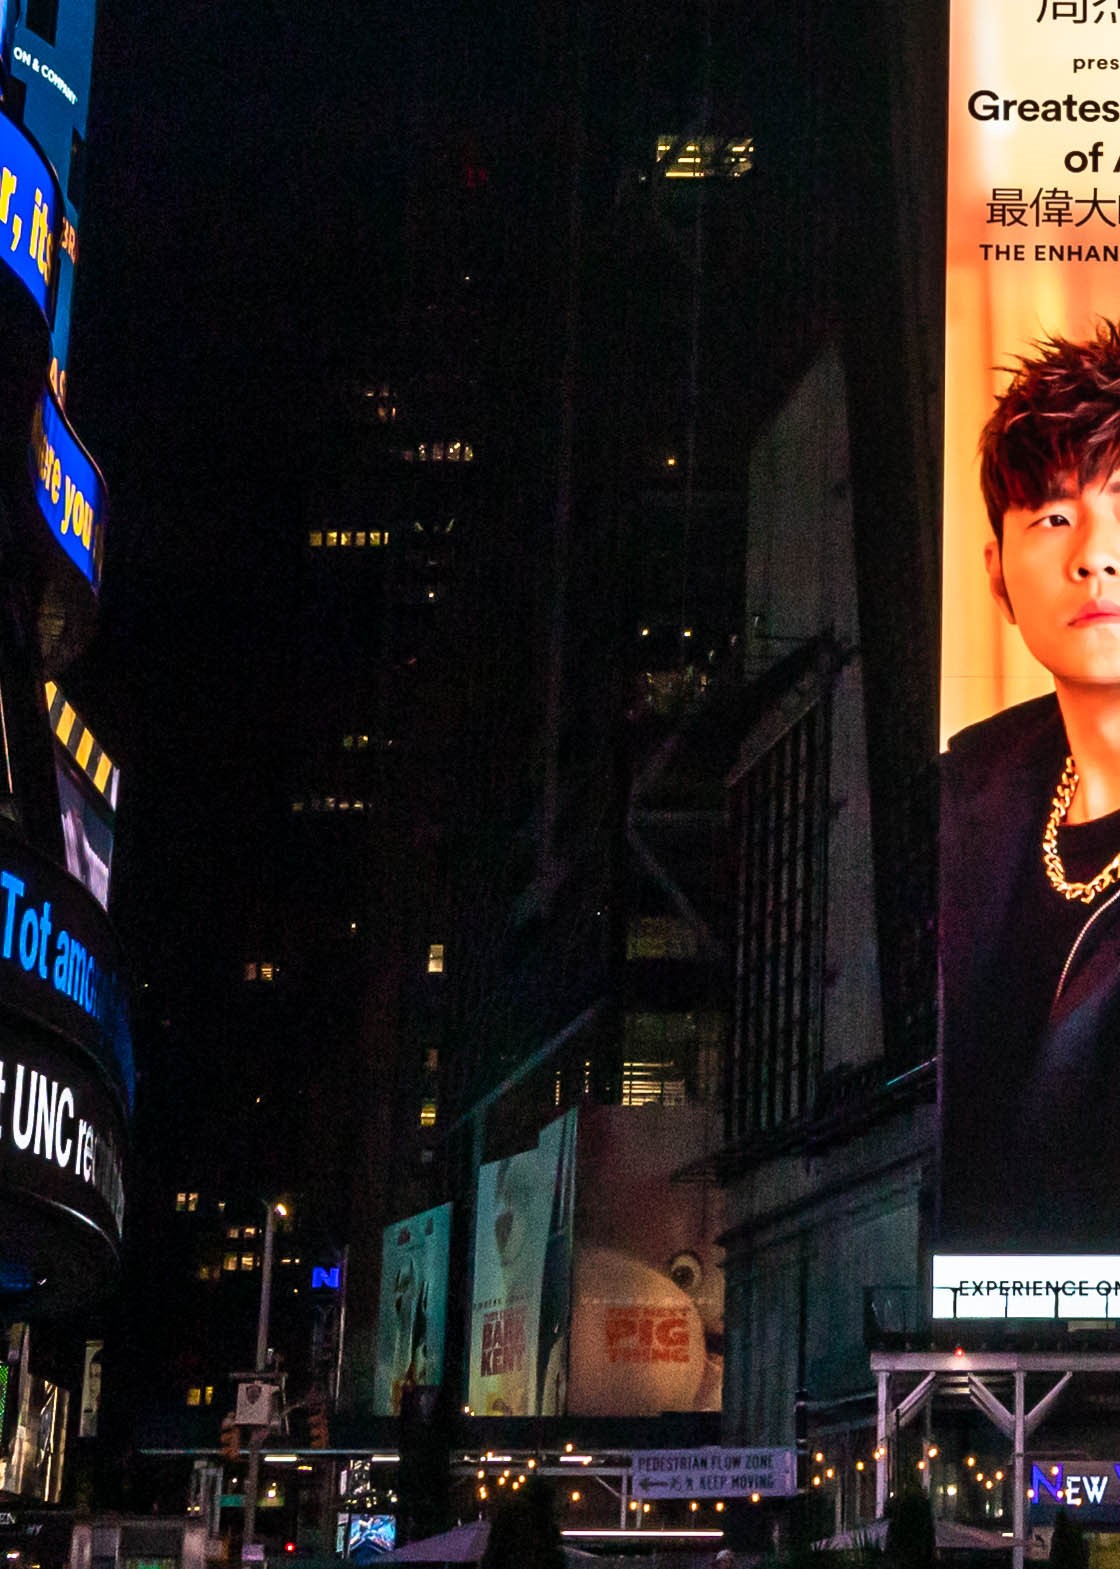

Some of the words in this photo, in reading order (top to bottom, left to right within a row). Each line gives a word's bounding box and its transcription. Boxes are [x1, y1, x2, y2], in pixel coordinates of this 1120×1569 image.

[1064, 141, 1104, 173] of
[979, 244, 1026, 262] THE
[12, 1064, 75, 1169] UNC
[959, 1280, 1089, 1297] EXPERIENCE
[606, 1319, 690, 1347] PIG
[638, 1455, 708, 1472] PEDESTRIAN
[711, 1455, 742, 1470] FLOW
[745, 1454, 774, 1469] ZONE
[699, 1476, 729, 1490] KEEP
[731, 1474, 775, 1489] MOVING
[1031, 1463, 1108, 1506] NEW
